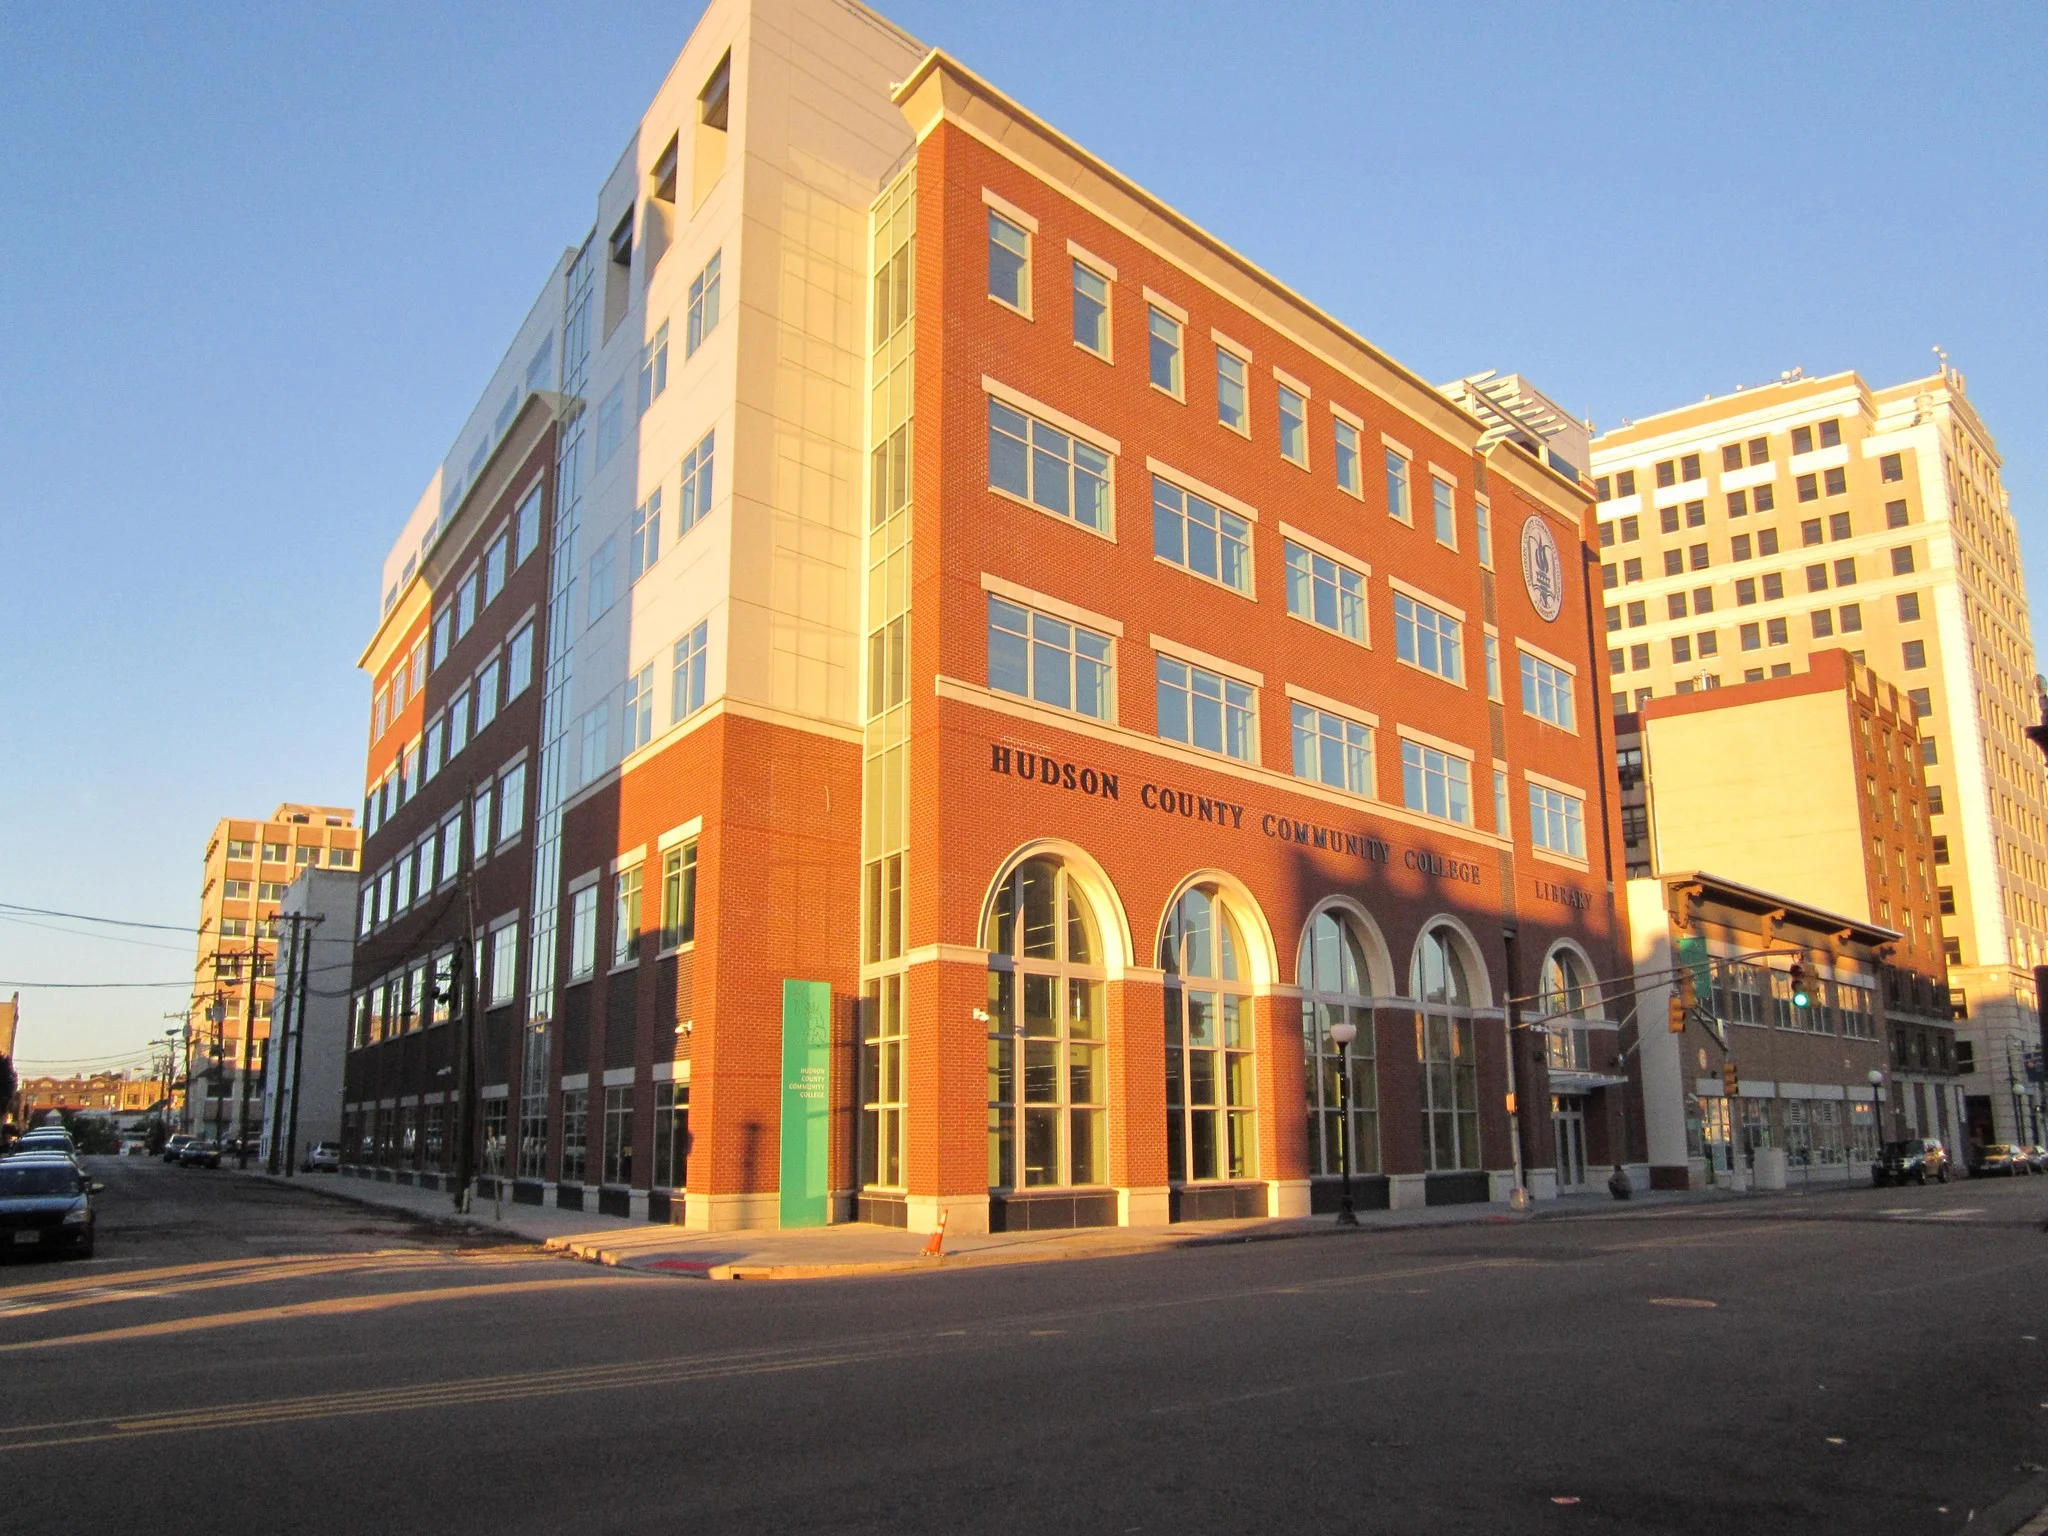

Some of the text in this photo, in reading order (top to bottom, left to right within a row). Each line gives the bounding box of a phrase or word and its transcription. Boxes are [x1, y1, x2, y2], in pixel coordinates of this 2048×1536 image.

[991, 743, 1481, 885] HUDSON COUNTY COMMUNITY COLLEGE
[1535, 880, 1592, 911] LIBRARY
